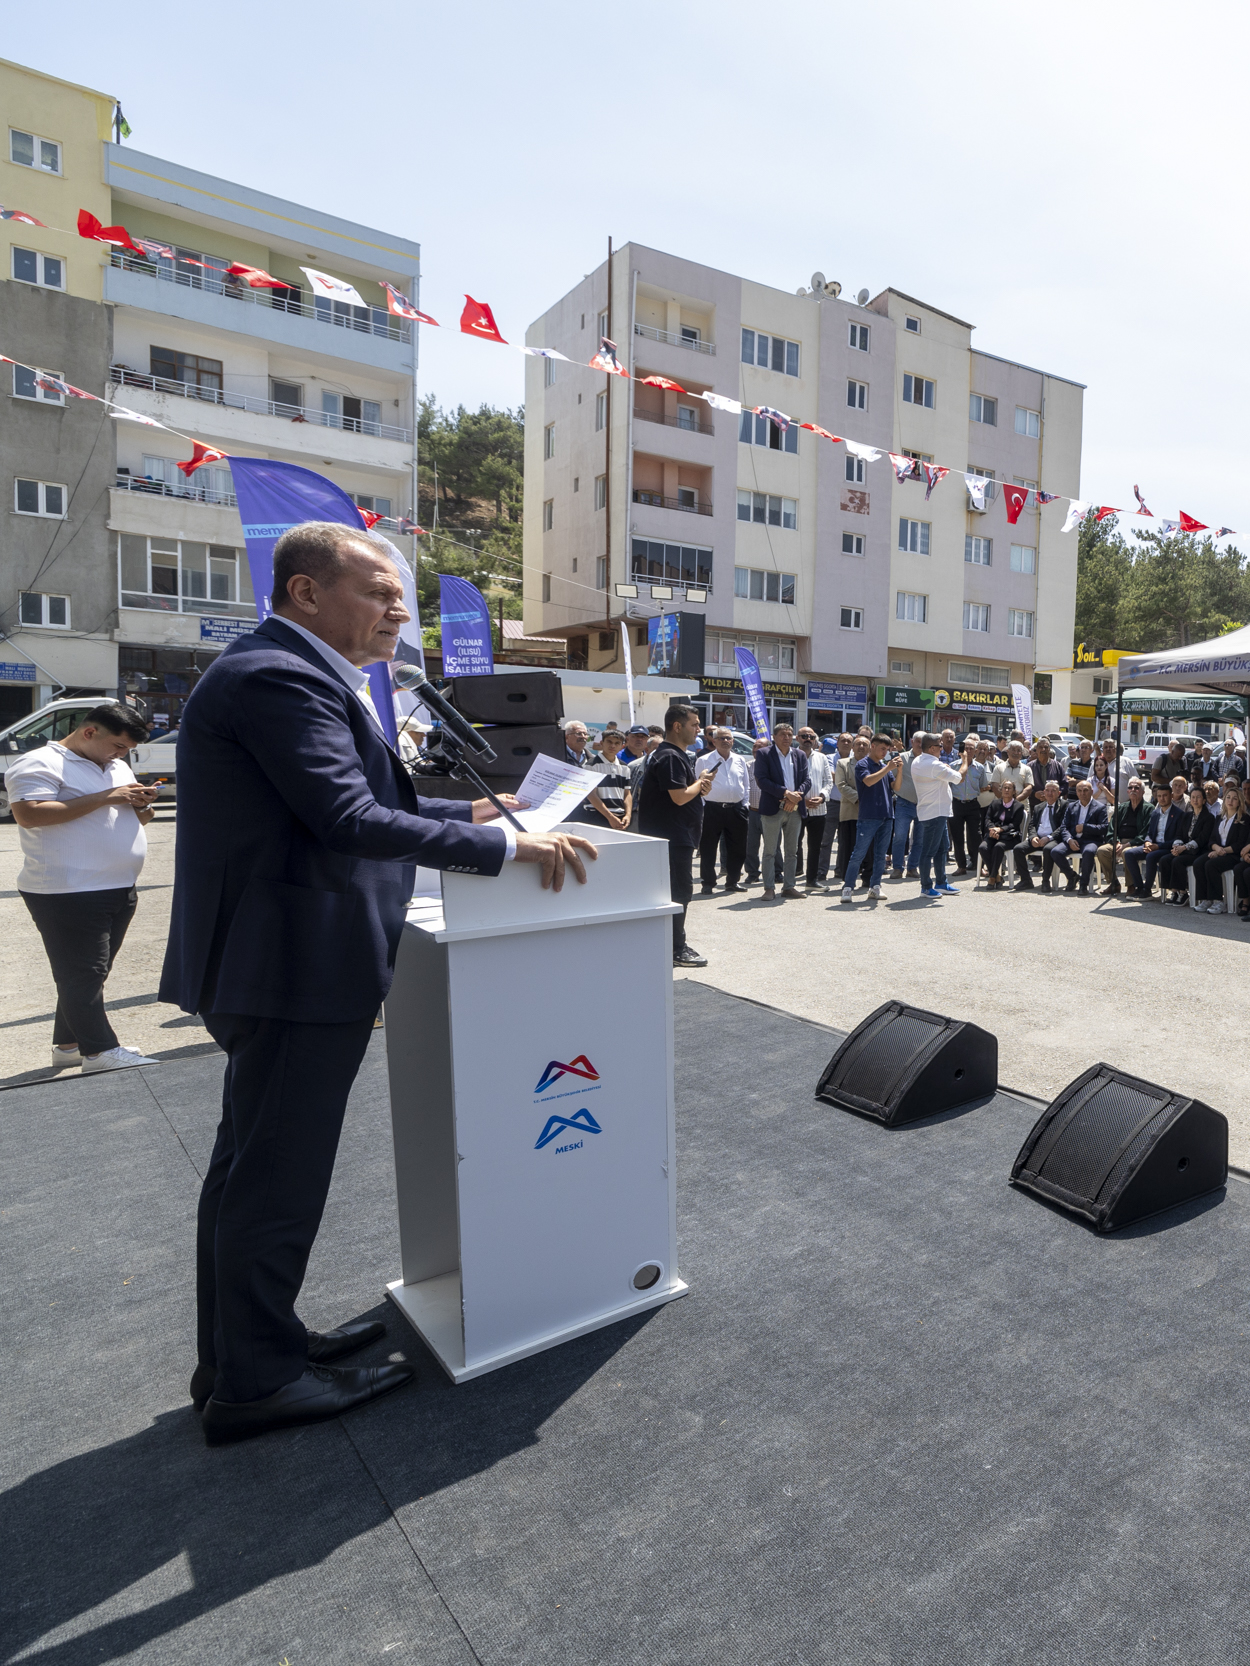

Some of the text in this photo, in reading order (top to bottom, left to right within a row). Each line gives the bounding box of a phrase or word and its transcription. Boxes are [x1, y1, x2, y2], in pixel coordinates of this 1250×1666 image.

[452, 637, 483, 646] GÜLNAR
[458, 647, 481, 657] (ILISU)
[446, 655, 489, 666] İÇME SUYU
[471, 665, 490, 673] HATTI
[1158, 665, 1172, 675] T.C.
[1174, 659, 1211, 674] MERSİN
[702, 678, 732, 688] YILDIZ
[953, 691, 1008, 705] BAKIRLAR
[555, 1139, 584, 1155] MESKİ
